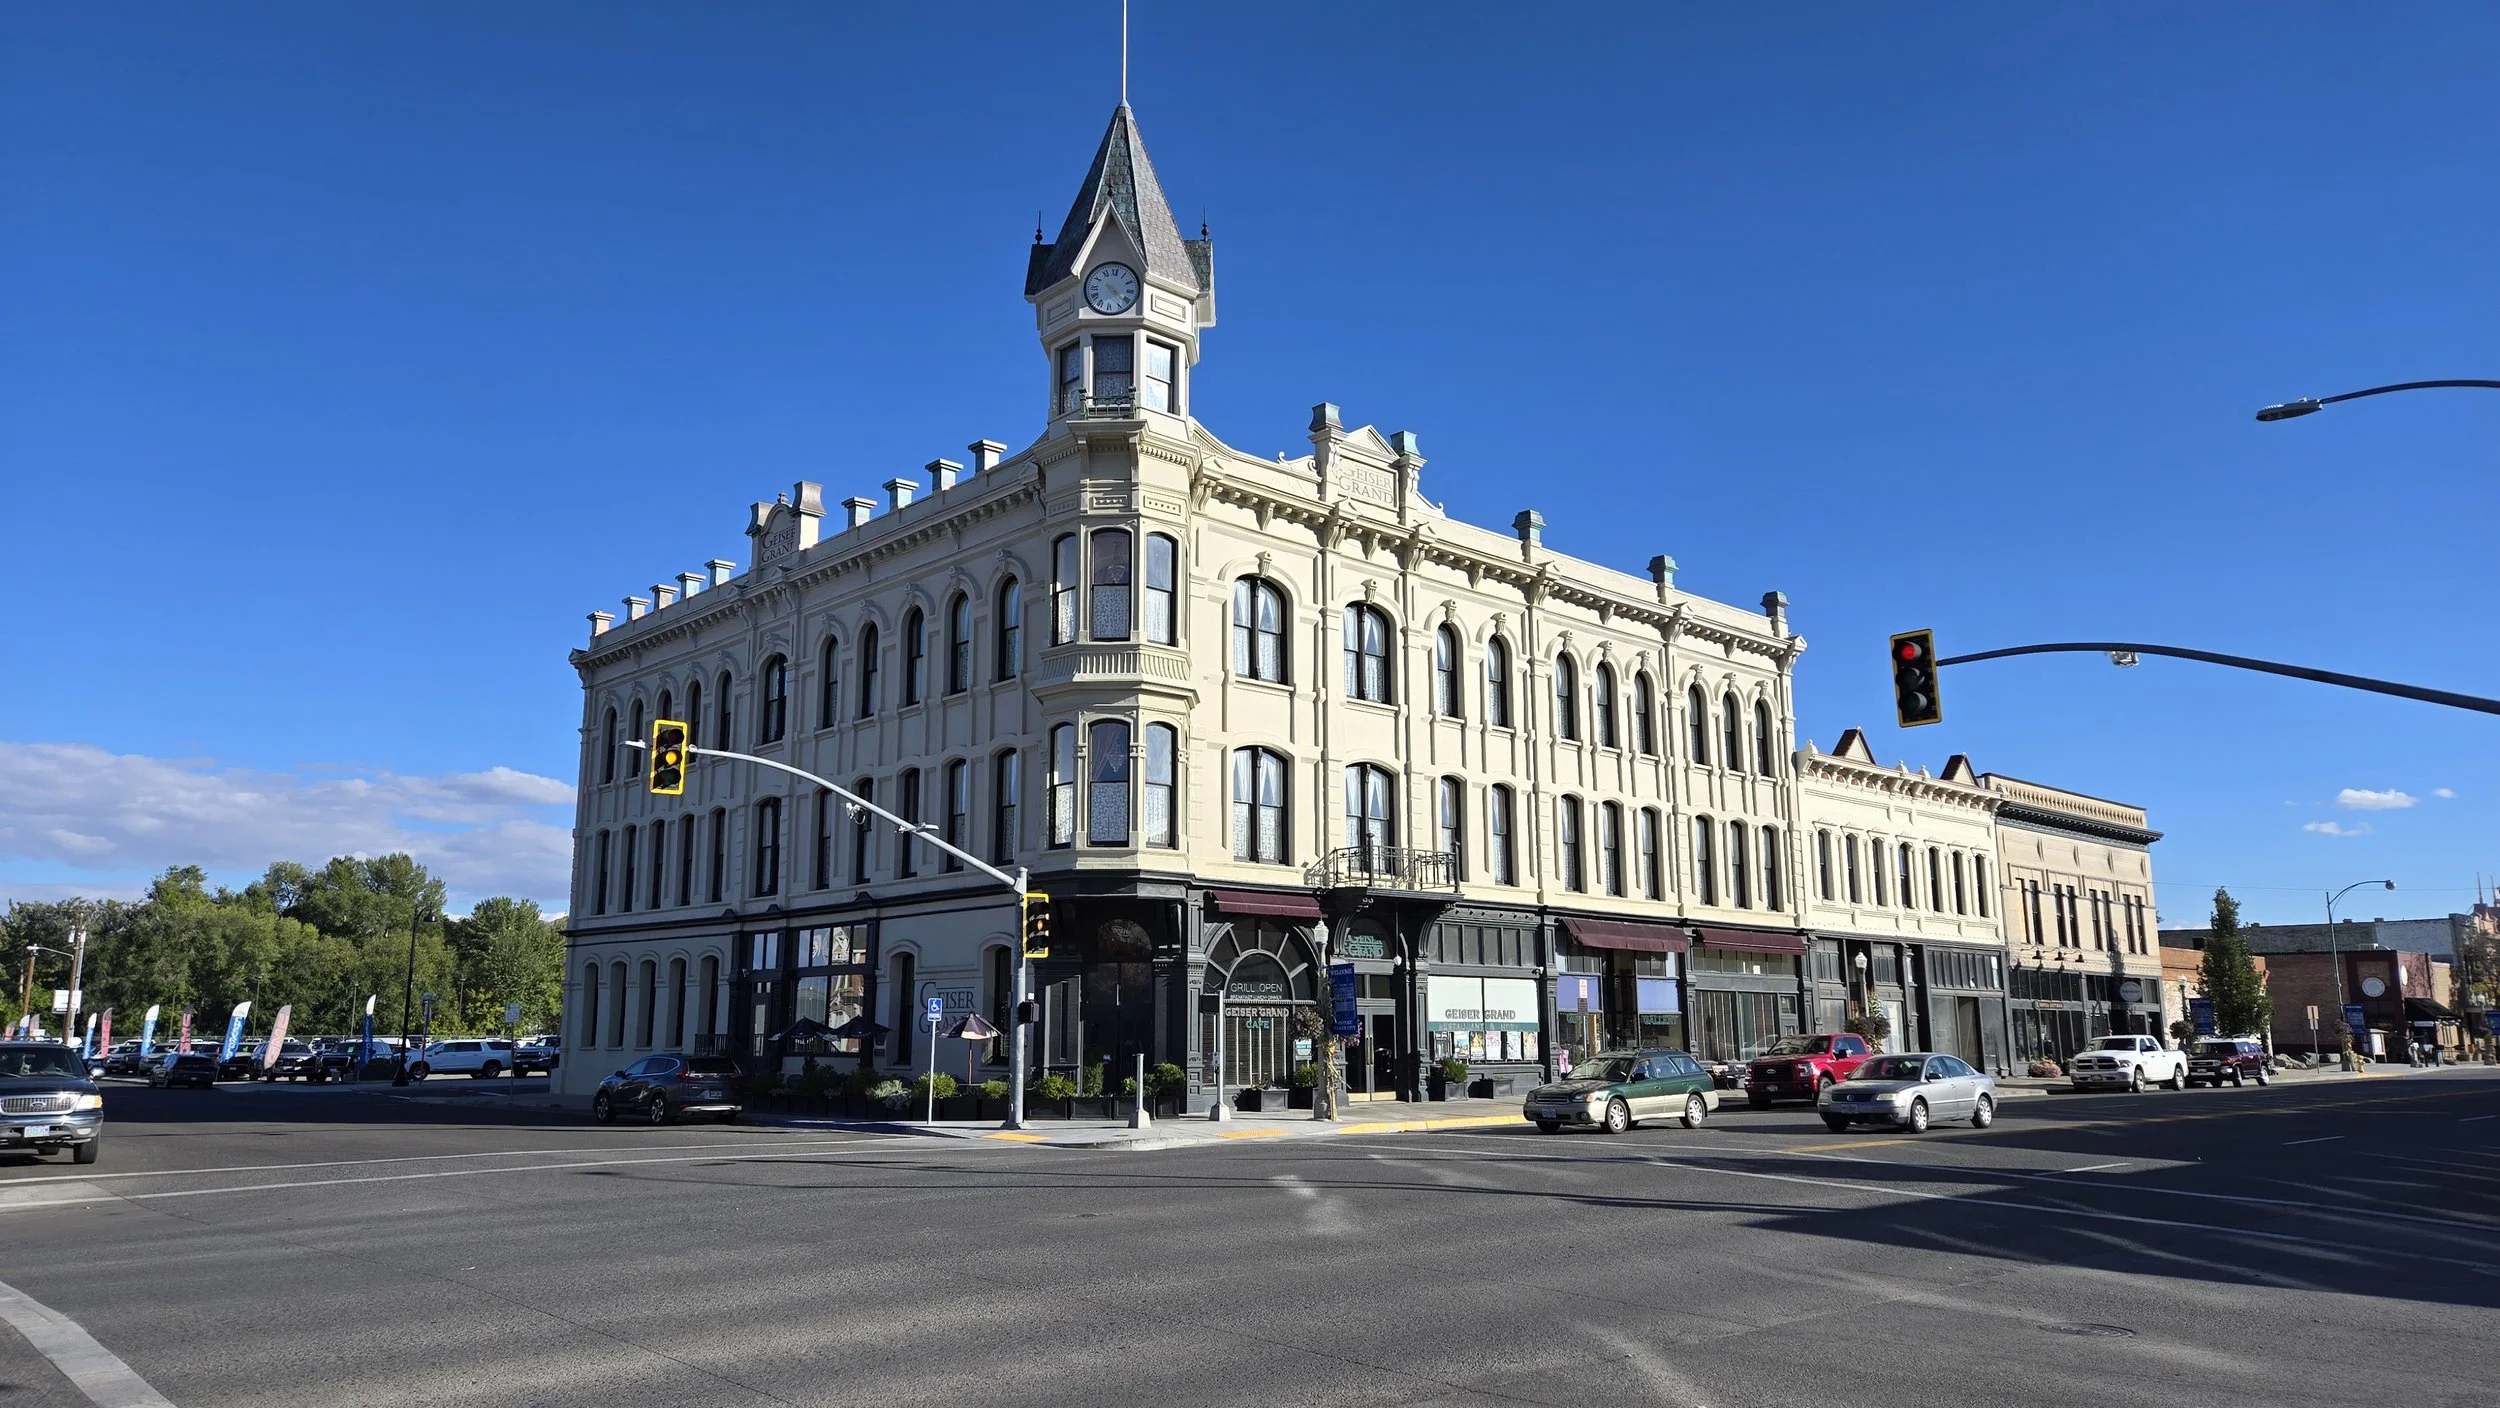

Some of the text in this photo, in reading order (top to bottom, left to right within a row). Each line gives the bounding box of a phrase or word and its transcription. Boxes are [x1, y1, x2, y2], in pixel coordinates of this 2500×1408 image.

[1339, 475, 1394, 504] GRAND
[1230, 983, 1282, 993] GRILL OPEN
[1225, 1007, 1289, 1017] GEISER GRAND
[1445, 1008, 1516, 1020] GEISER GRAND
[1245, 1020, 1270, 1029] CAFE
